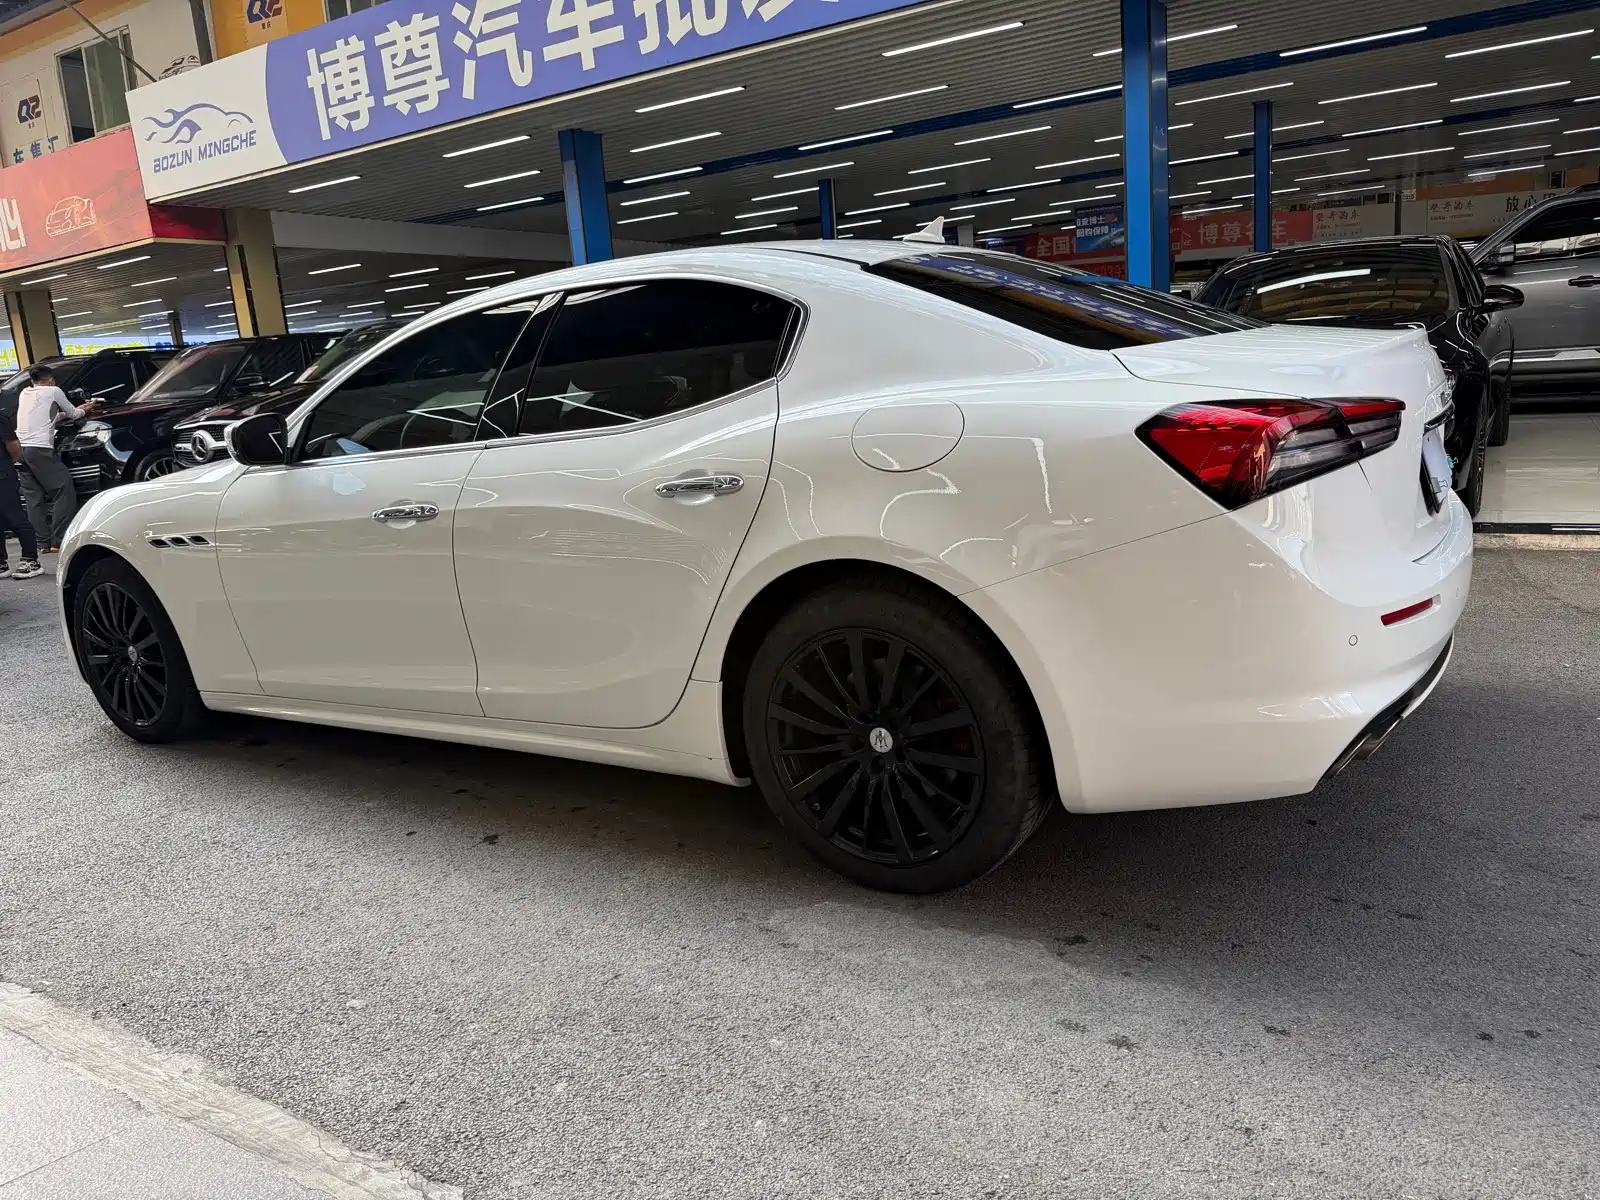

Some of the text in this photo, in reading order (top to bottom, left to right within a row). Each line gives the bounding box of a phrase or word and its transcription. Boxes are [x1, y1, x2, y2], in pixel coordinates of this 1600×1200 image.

[306, 0, 839, 141] 博尊汽车
[153, 129, 257, 174] BOZUN MINGCHE
[1505, 192, 1557, 213] 放心
[1037, 235, 1076, 257] 全国
